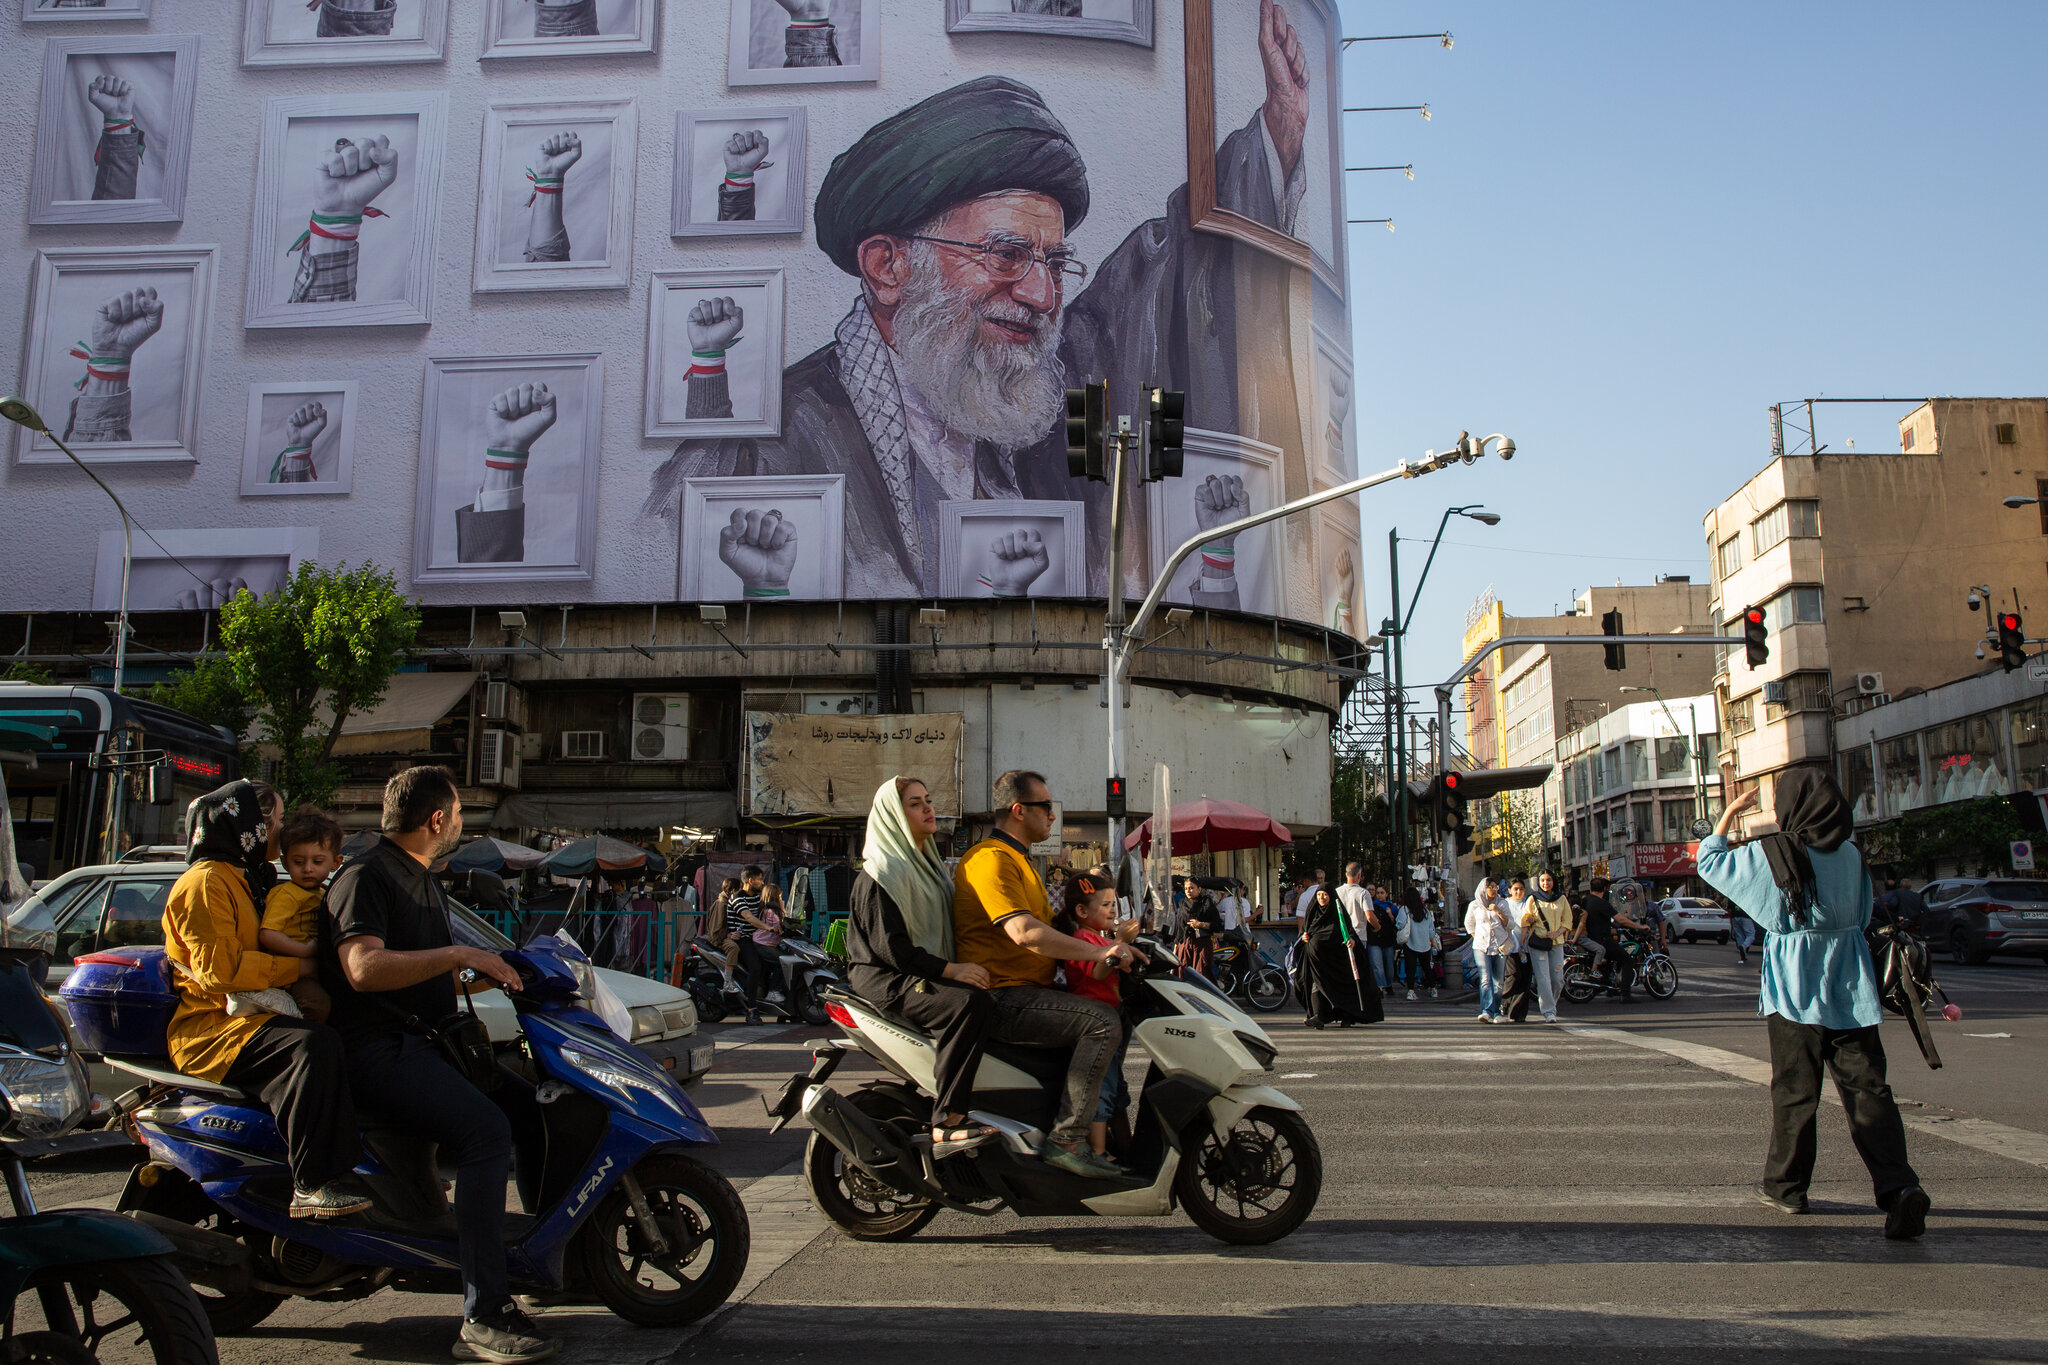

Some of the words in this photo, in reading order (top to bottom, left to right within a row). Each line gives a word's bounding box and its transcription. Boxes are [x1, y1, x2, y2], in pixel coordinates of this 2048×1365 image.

[811, 725, 834, 744] روشا
[891, 727, 912, 740] لاک
[914, 727, 946, 744] دنیای
[1636, 844, 1666, 855] HONAR
[1637, 855, 1667, 865] TOWEL
[1164, 1026, 1196, 1039] NMS
[566, 1155, 614, 1218] LIFAN
